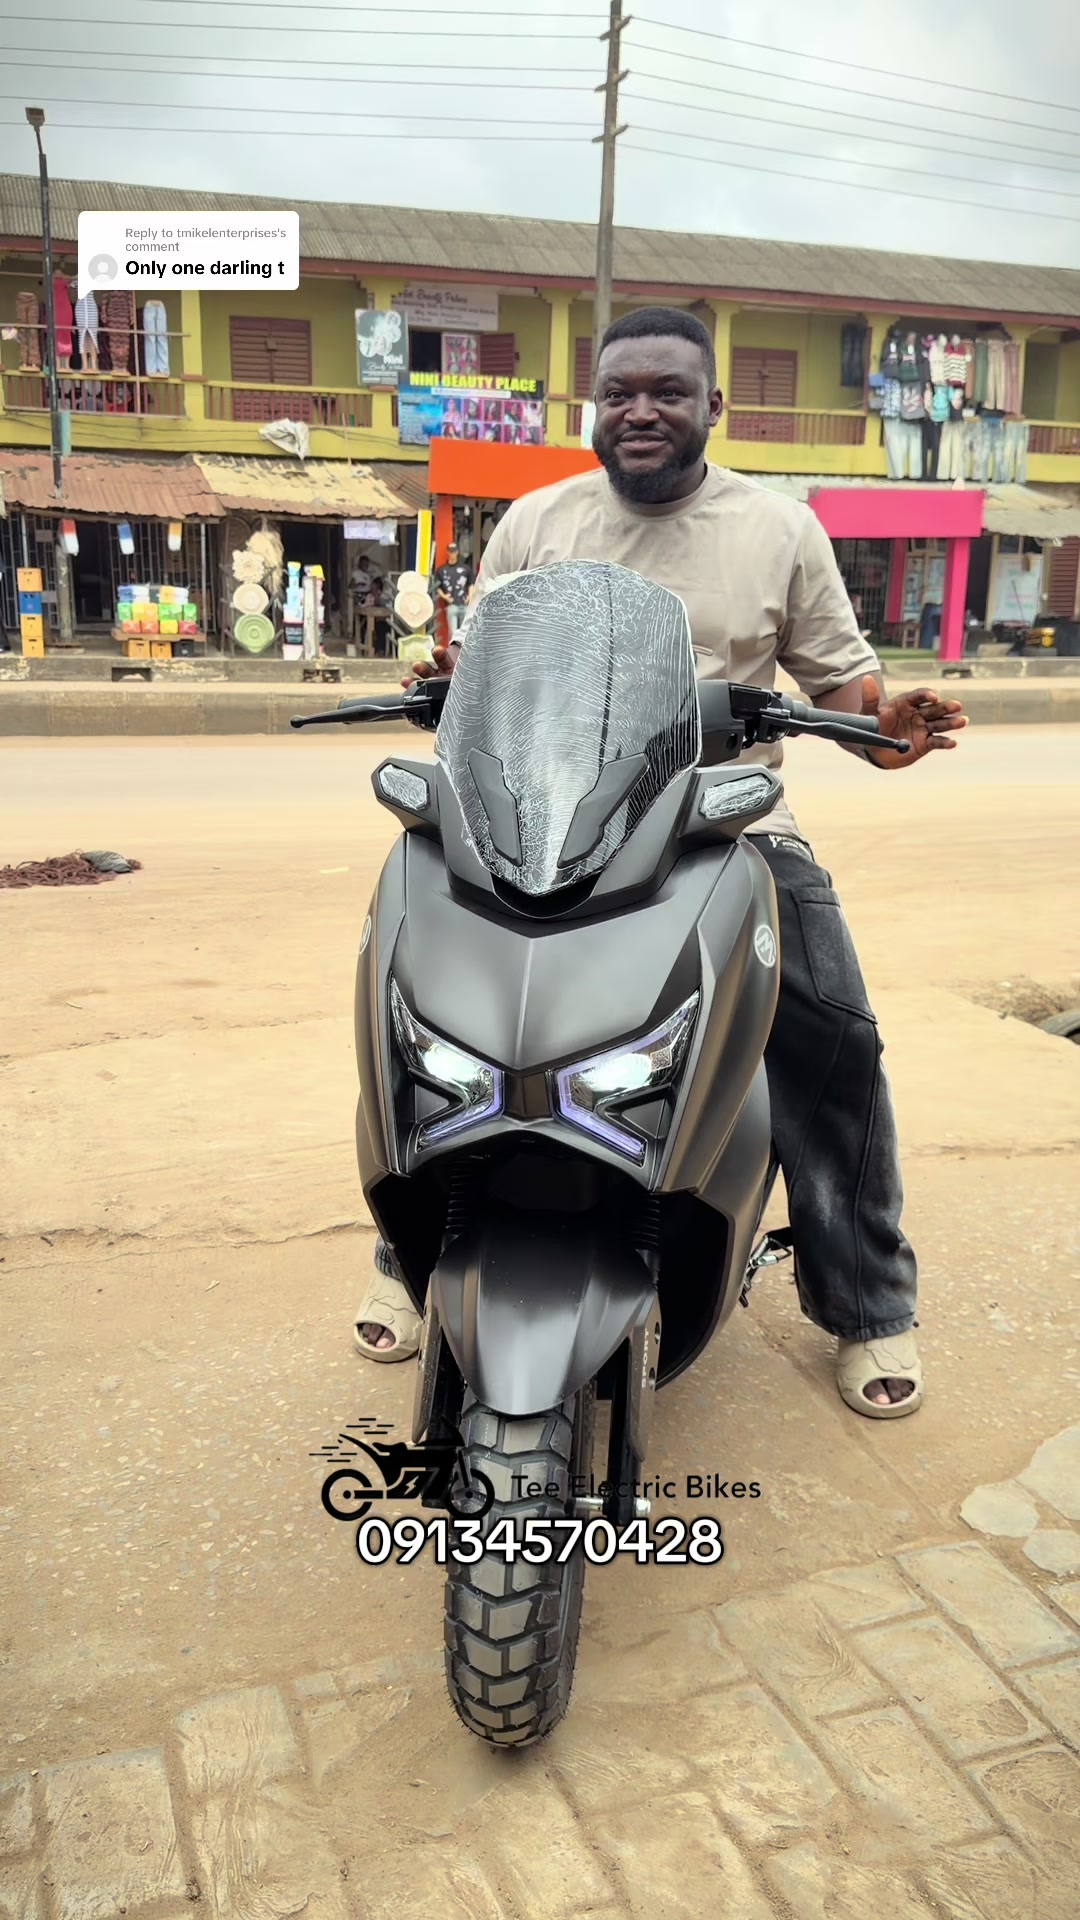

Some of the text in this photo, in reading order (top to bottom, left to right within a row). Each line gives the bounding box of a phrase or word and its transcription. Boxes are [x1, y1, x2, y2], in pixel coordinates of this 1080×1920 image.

[409, 371, 440, 387] NINI
[441, 373, 494, 390] BEAUTY
[495, 376, 537, 393] PLACE
